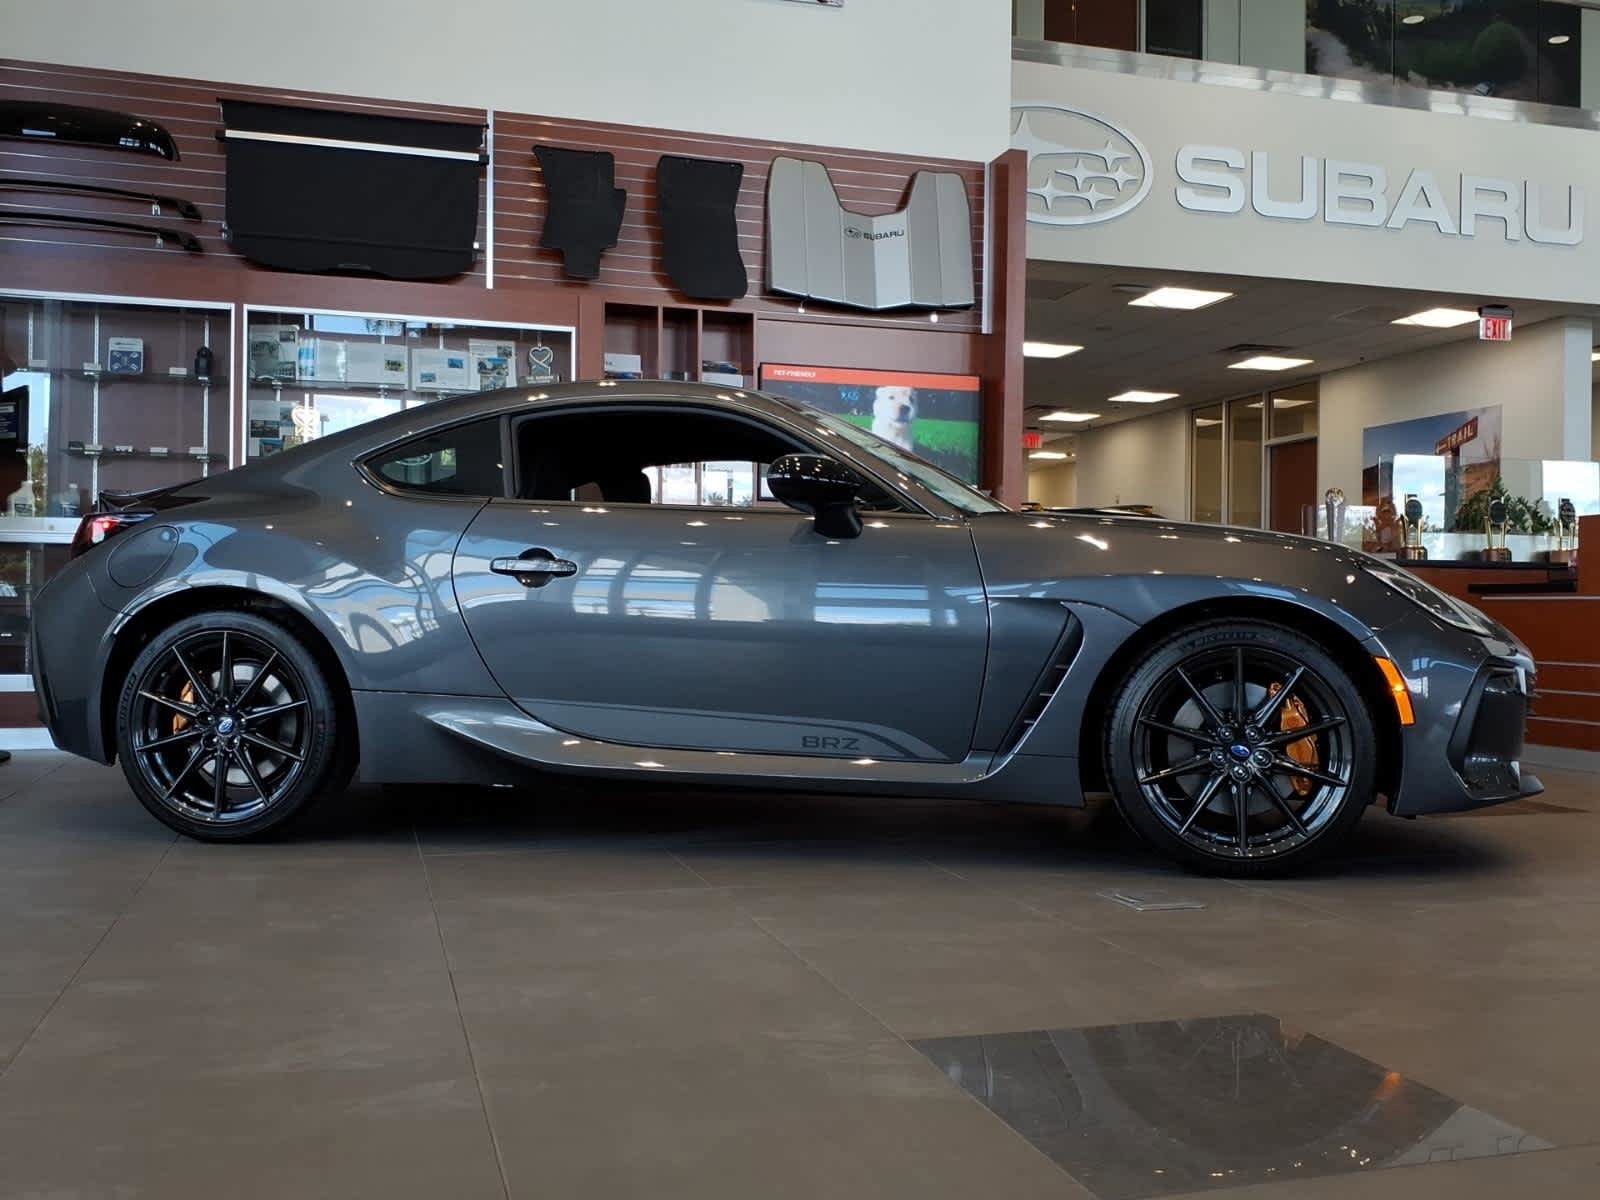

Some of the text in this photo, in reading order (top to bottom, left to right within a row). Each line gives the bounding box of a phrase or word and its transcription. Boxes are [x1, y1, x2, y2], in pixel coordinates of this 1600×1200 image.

[1175, 144, 1585, 246] SUBARU
[863, 229, 904, 240] SUBARU
[1485, 318, 1507, 338] EXIT
[802, 735, 860, 751] BRZ
